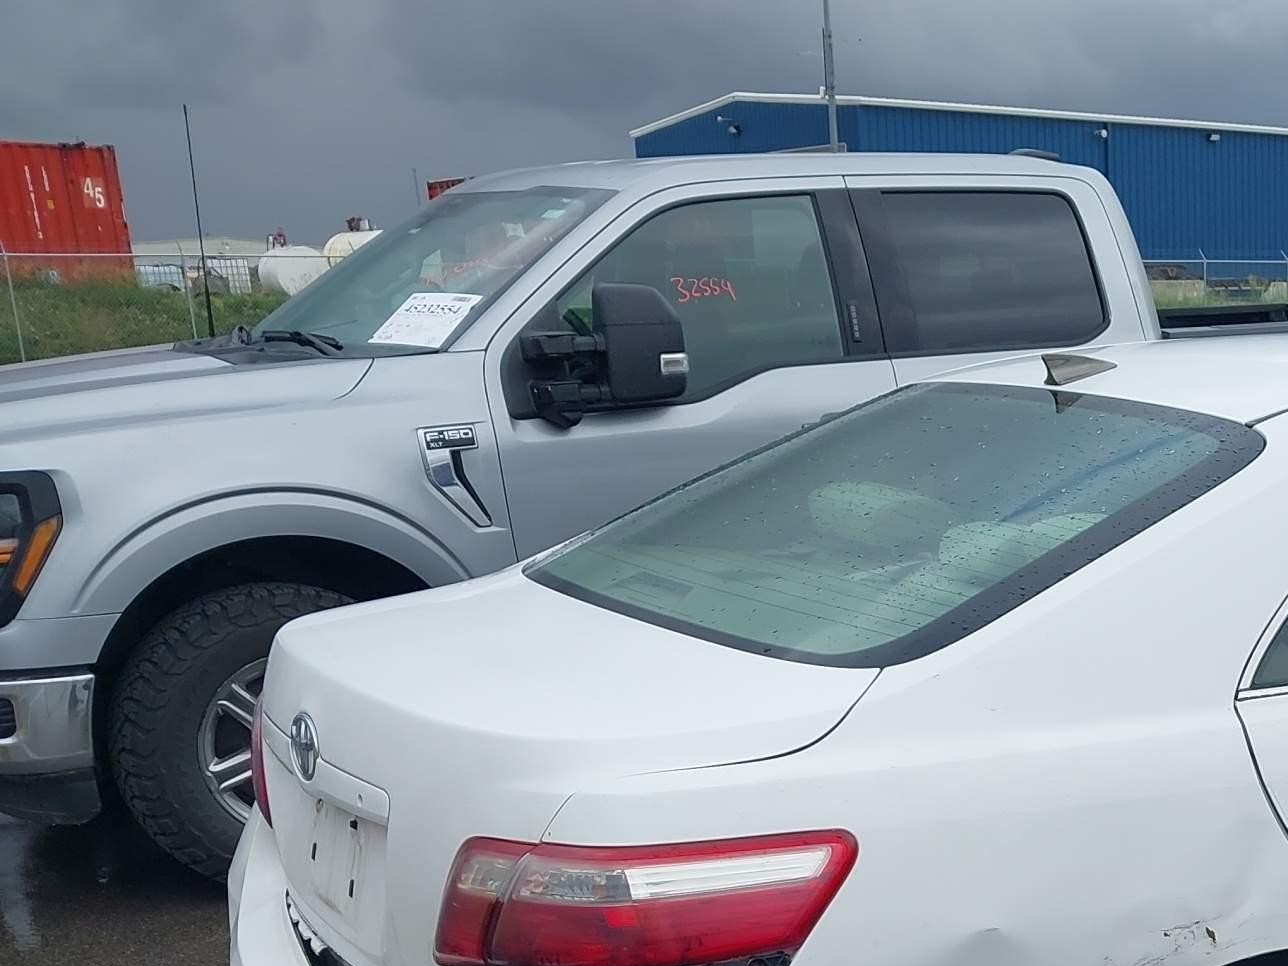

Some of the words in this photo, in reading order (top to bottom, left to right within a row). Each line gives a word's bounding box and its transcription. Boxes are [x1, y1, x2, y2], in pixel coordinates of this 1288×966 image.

[84, 176, 105, 208] 45
[670, 276, 737, 303] 32554
[425, 428, 473, 441] F-150
[428, 441, 444, 449] XLT
